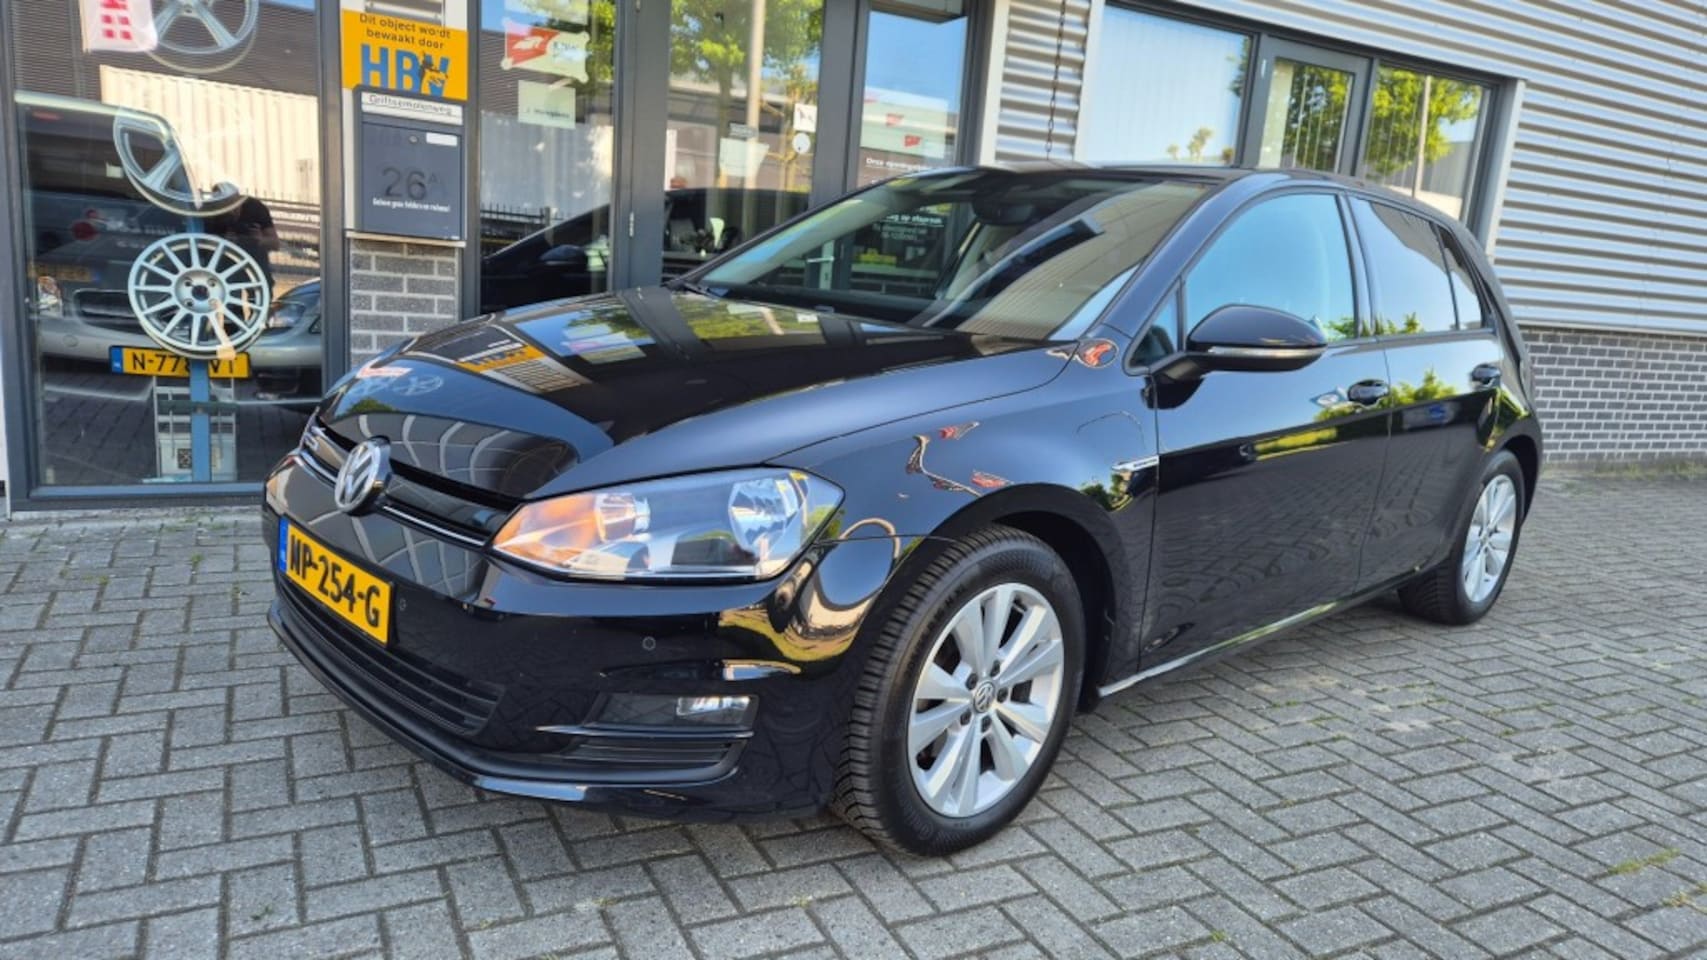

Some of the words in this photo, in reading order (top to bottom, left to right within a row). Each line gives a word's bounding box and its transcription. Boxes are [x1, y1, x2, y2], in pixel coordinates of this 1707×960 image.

[359, 13, 377, 26] Dit
[379, 17, 416, 32] object
[366, 28, 415, 45] bewaakt
[418, 38, 444, 50] door
[290, 534, 381, 628] NP-254-G
